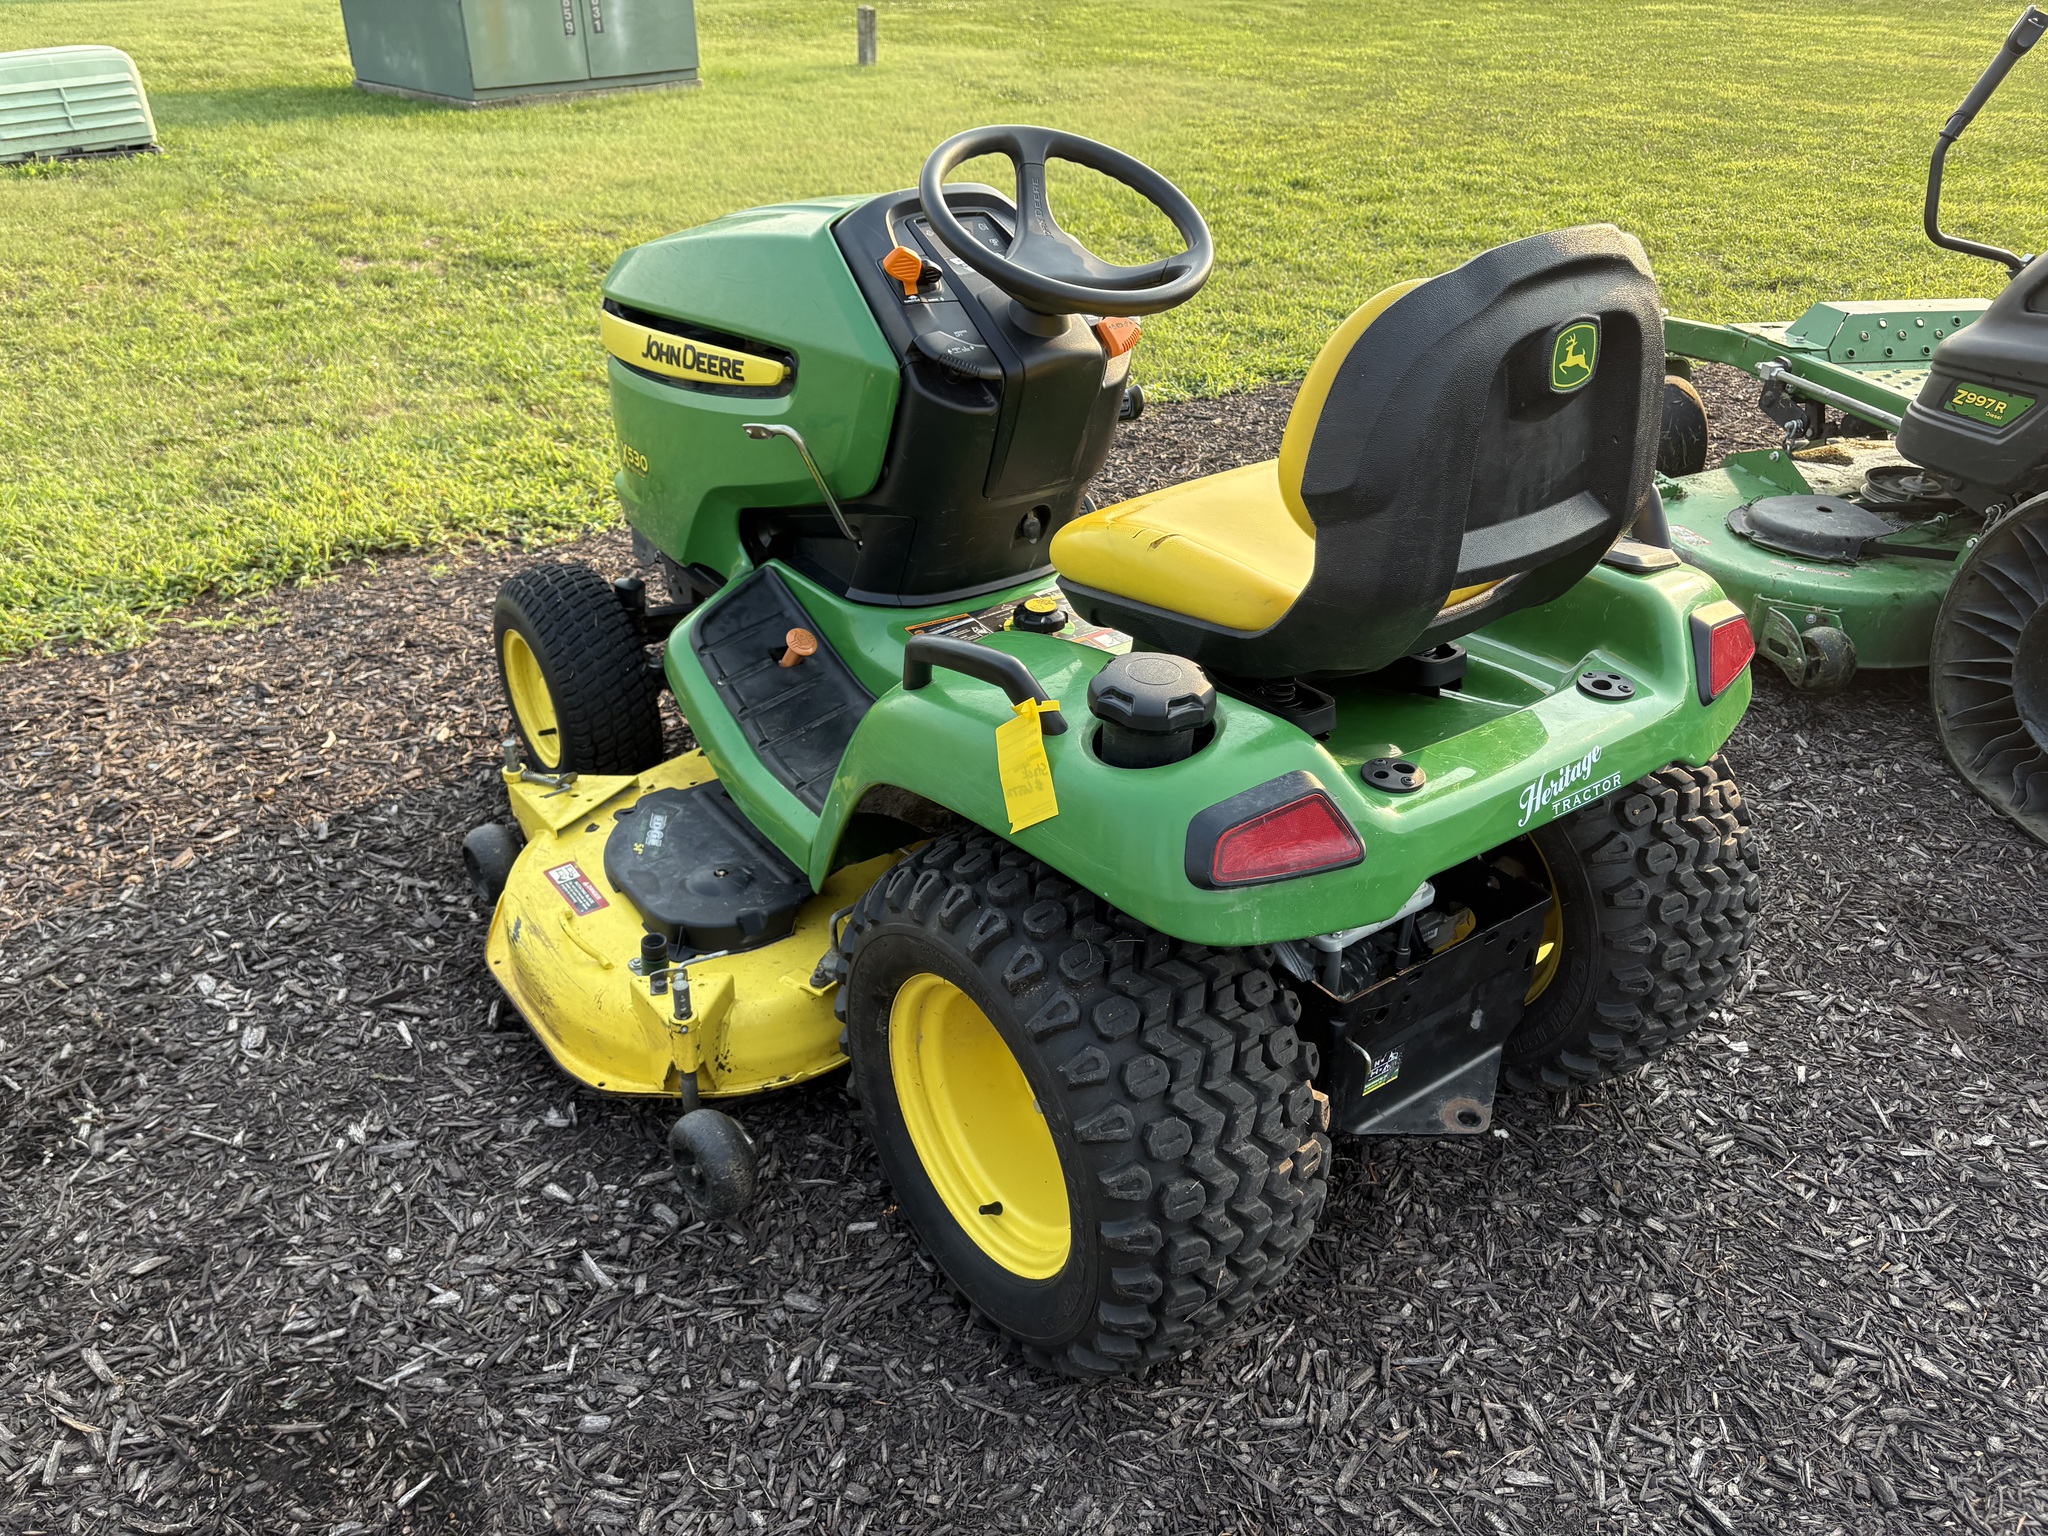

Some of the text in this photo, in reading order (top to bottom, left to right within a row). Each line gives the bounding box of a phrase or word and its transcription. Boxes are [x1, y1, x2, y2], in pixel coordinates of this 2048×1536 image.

[642, 334, 745, 382] JOHN DEERE
[1952, 388, 2008, 414] Z997R
[1985, 411, 2003, 421] Diesel
[620, 439, 649, 472] X530
[1518, 745, 1602, 828] Heritage
[1552, 774, 1622, 816] TRACTOR
